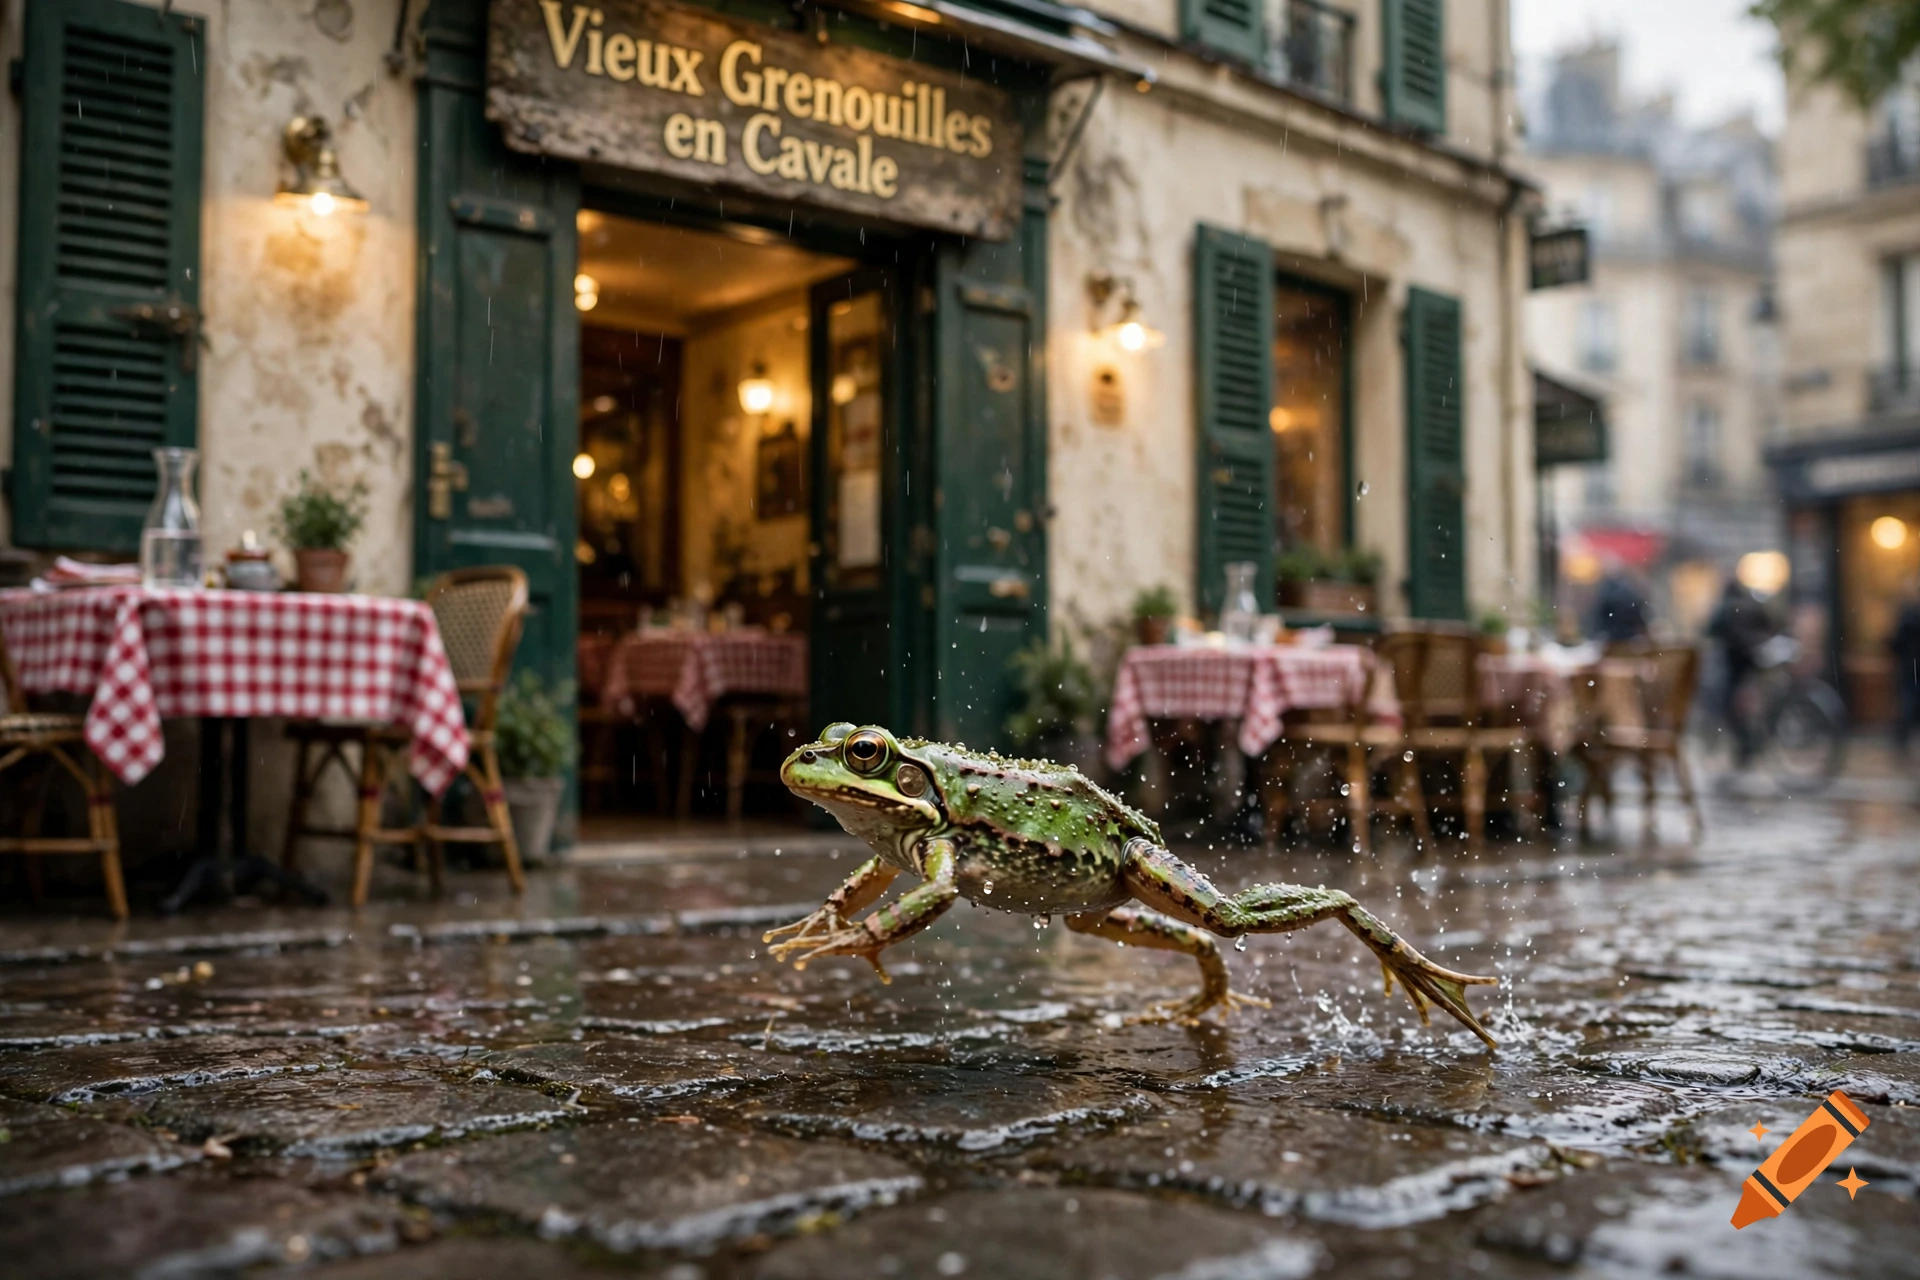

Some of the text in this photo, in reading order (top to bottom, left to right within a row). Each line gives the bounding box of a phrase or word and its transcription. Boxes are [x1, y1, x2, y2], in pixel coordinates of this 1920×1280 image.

[540, 0, 993, 158] Vieux Grenouilles
[664, 112, 900, 199] en Cavale
